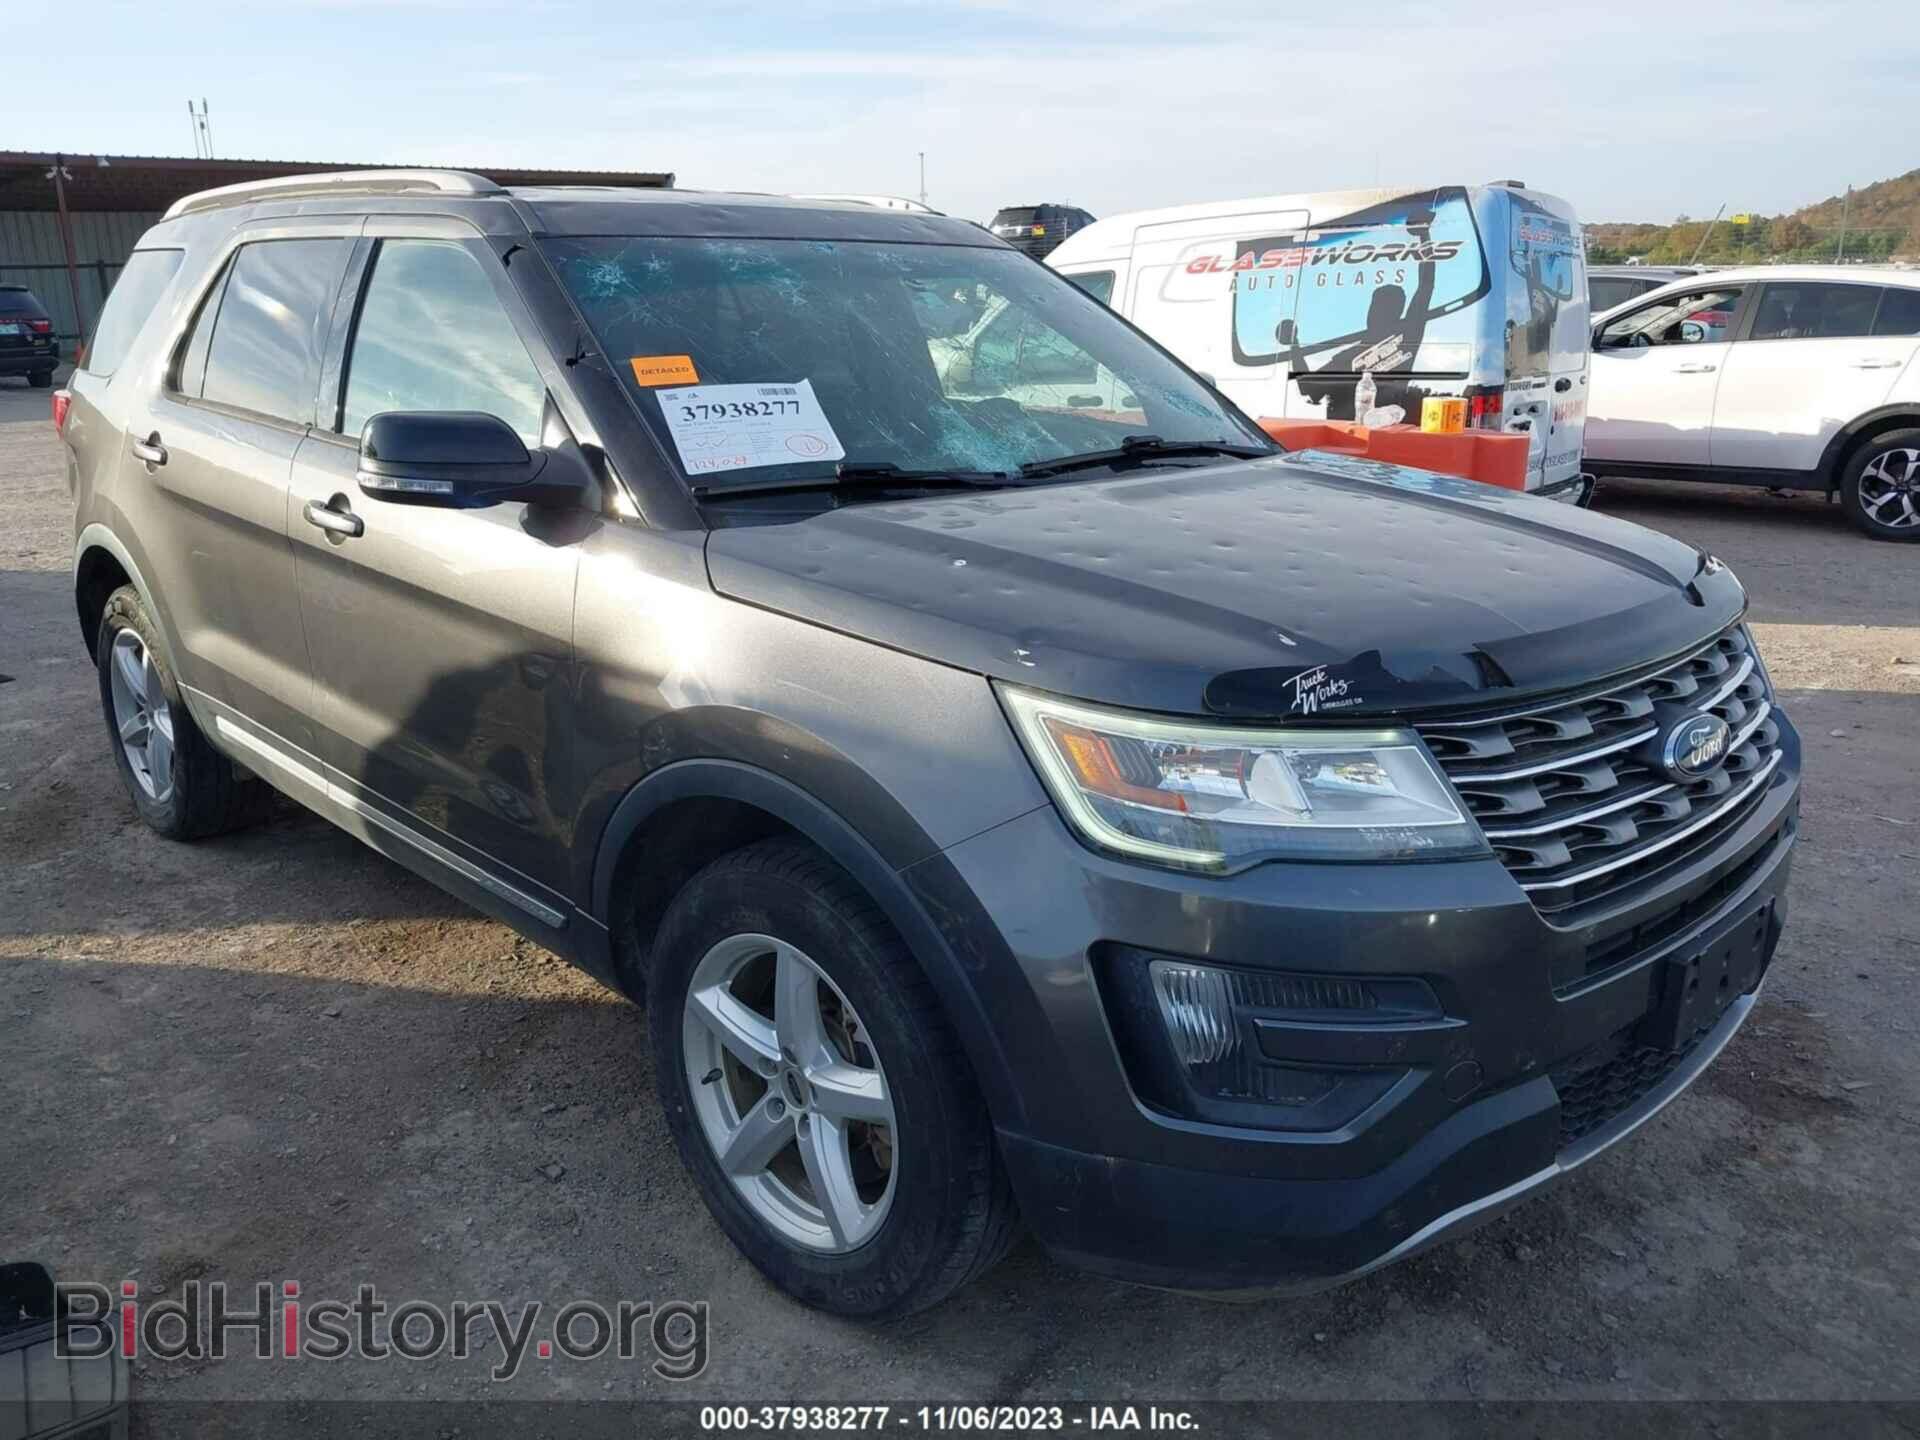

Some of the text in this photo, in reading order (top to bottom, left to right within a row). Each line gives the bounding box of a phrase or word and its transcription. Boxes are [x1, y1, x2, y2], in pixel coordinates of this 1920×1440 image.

[1185, 240, 1465, 274] GLASSWORKS
[1229, 268, 1406, 293] AUTO GLASS
[641, 367, 689, 376] DETAILED
[681, 401, 800, 421] 37938277
[1282, 664, 1328, 708] Truck
[1300, 679, 1354, 715] Works
